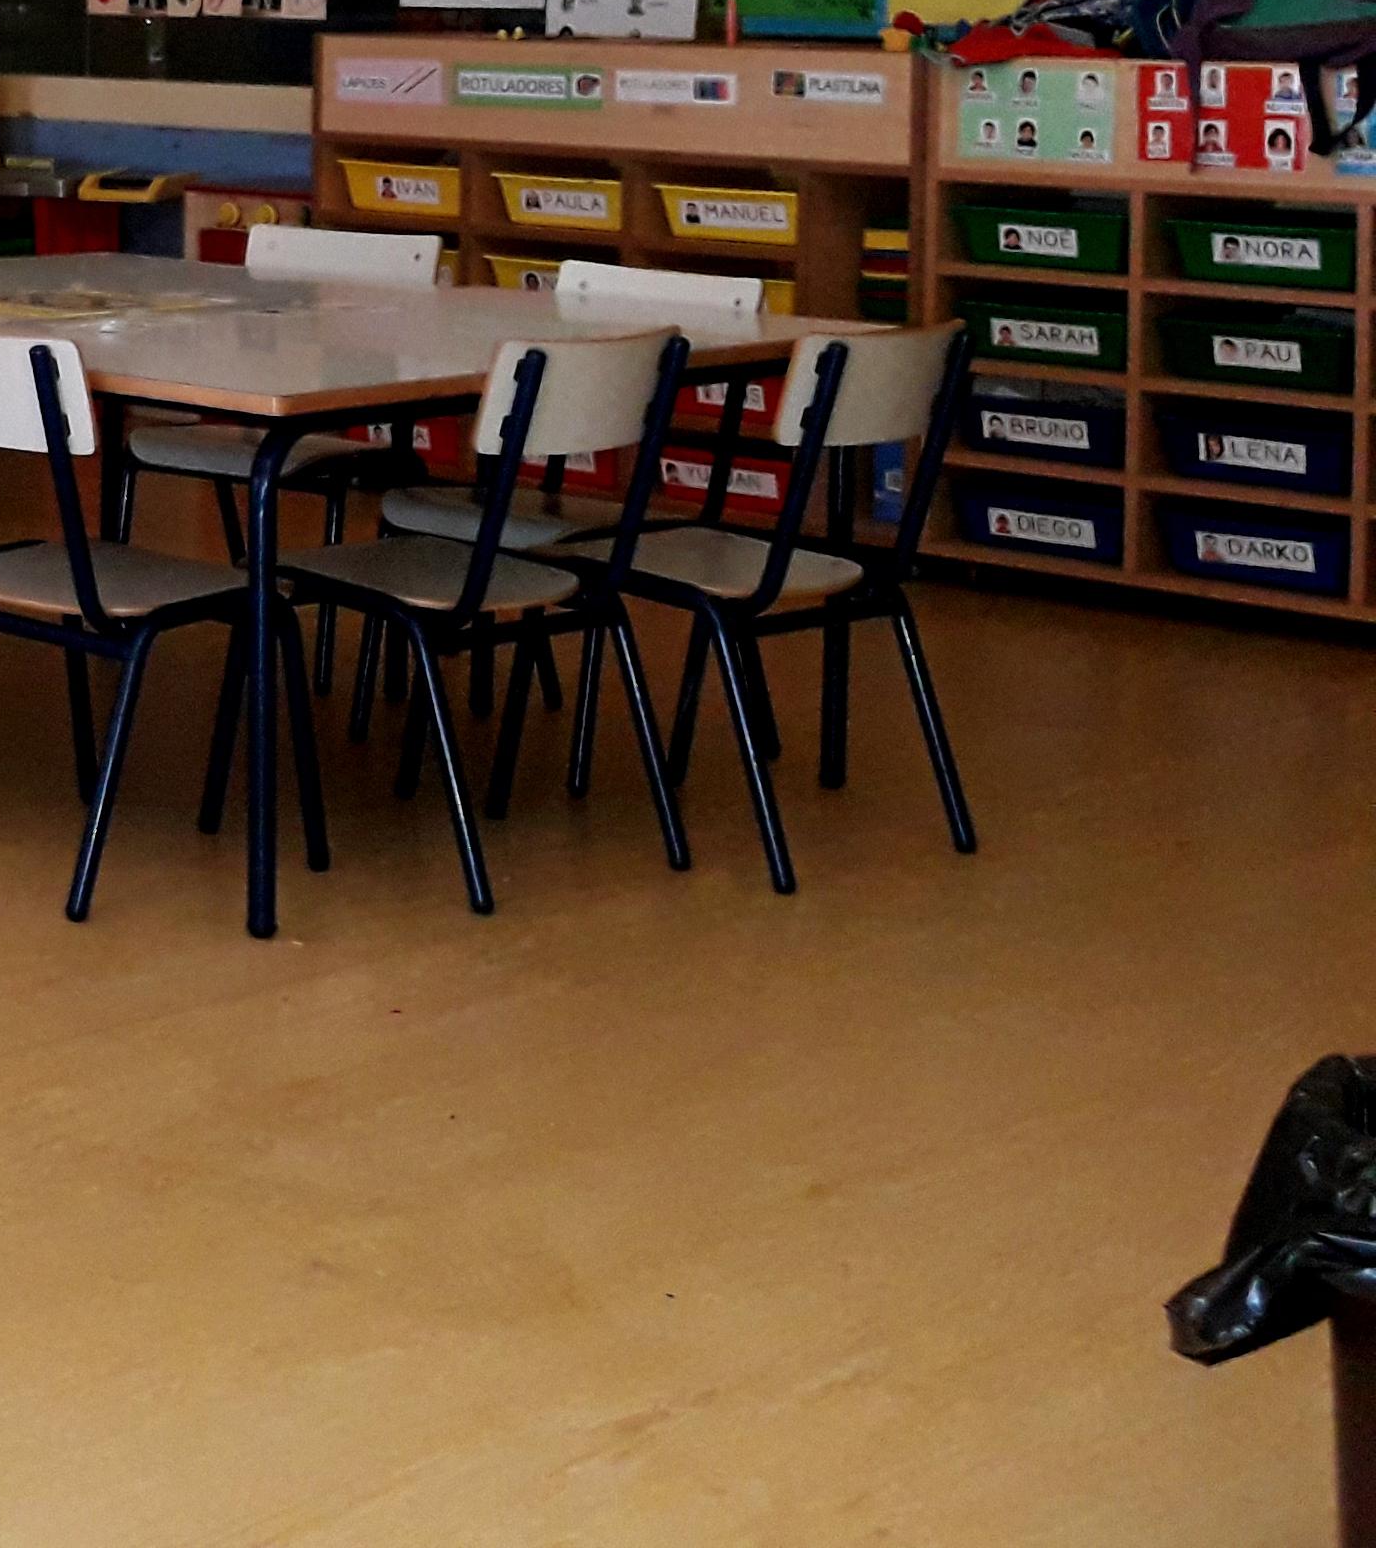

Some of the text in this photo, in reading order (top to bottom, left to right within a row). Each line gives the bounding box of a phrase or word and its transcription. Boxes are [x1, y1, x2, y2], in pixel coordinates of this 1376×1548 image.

[460, 75, 566, 96] ROTULADORES
[808, 77, 881, 95] PLASTILINA
[545, 193, 604, 212] PAULA
[703, 202, 785, 224] MANUEL
[1244, 239, 1314, 260] NORA
[1019, 322, 1095, 345] SARAH
[1243, 341, 1293, 363] PAU
[1010, 417, 1085, 442] BRUNO
[1230, 441, 1299, 464] LENA
[1015, 514, 1083, 540] DIEGO
[1227, 538, 1310, 564] DARKO
